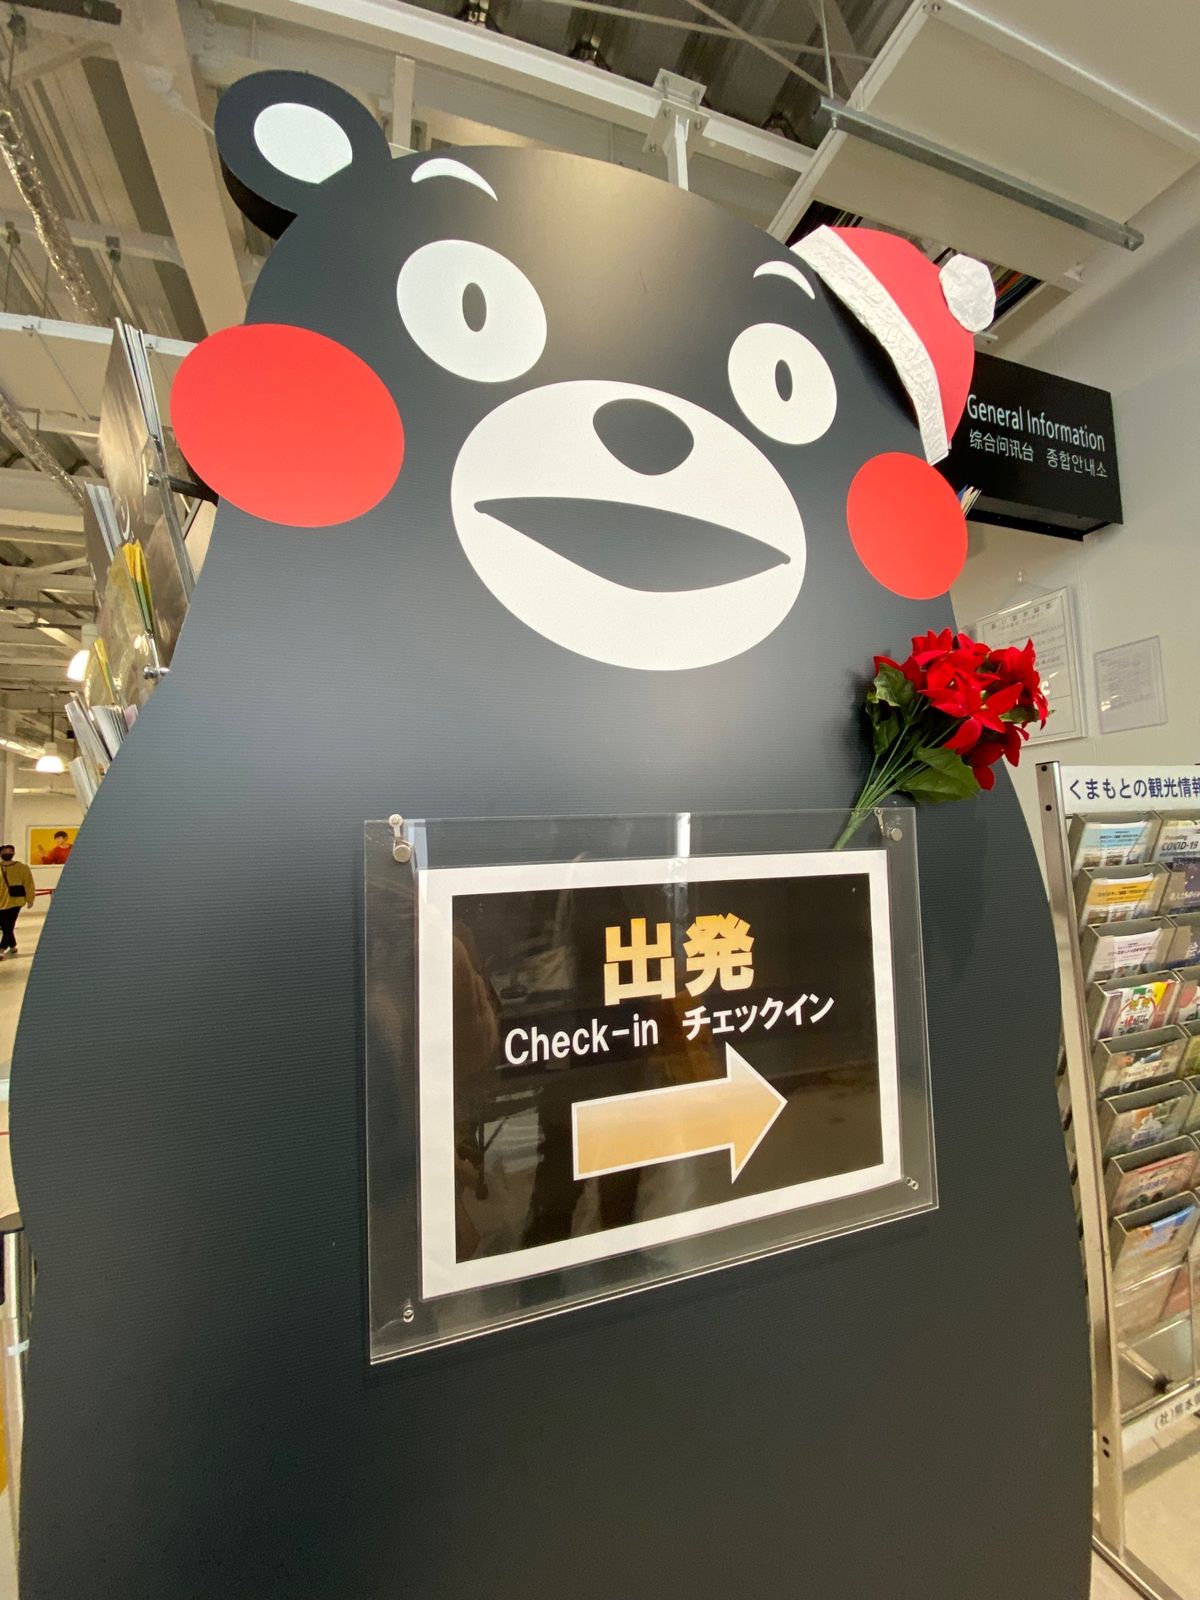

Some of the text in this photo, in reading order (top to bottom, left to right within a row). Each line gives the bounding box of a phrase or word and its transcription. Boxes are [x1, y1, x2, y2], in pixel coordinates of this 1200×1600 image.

[967, 394, 1106, 453] General Information
[970, 429, 1108, 478] 综合问讯台 종합안내소
[604, 913, 755, 1006] 出発
[504, 993, 834, 1065] Check-in チェックイン
